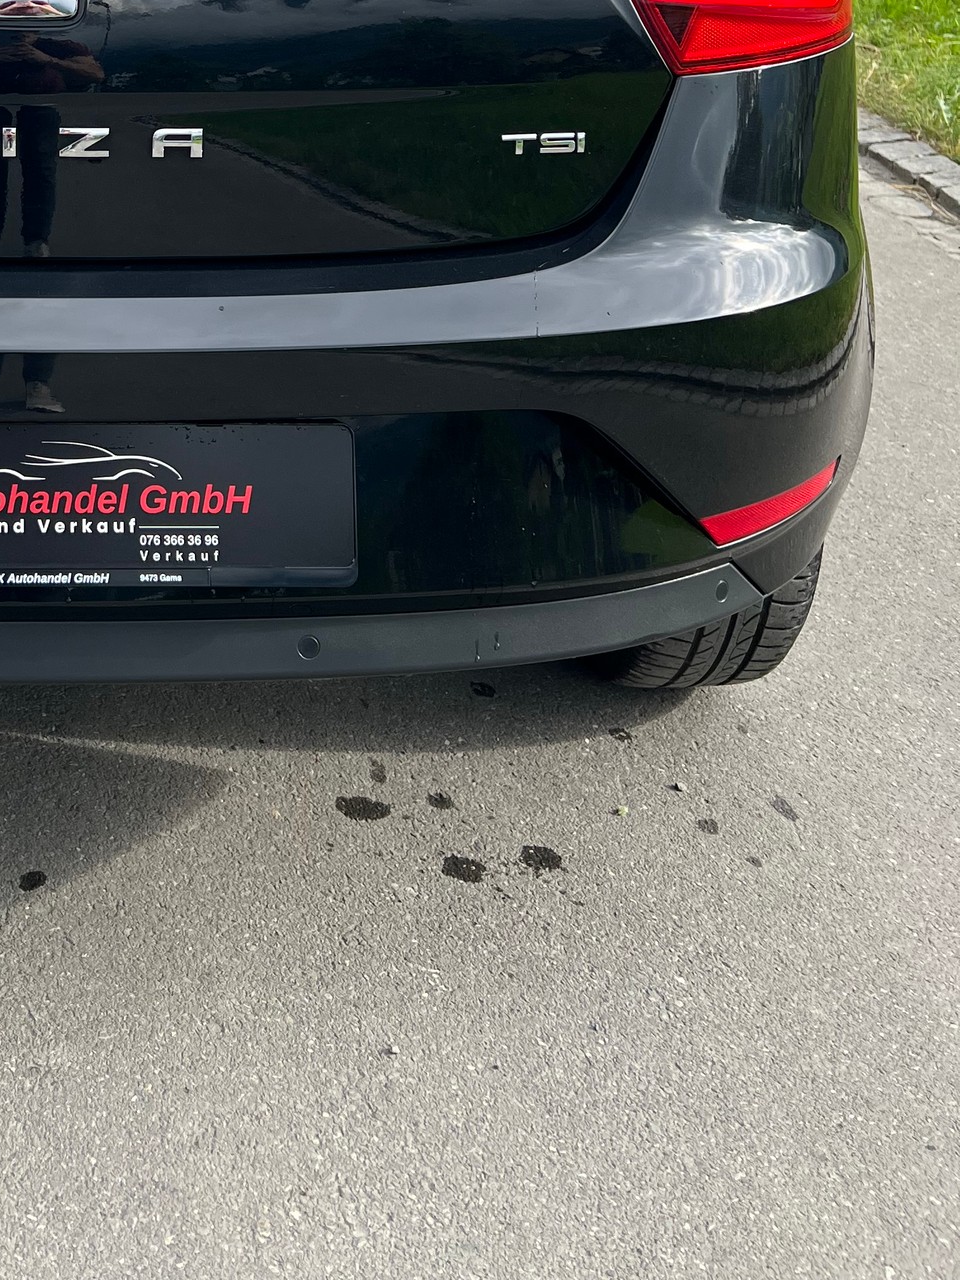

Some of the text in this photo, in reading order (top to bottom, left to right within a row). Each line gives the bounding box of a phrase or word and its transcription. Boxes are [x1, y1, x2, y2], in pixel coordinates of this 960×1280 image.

[501, 132, 586, 155] TSI
[139, 483, 253, 515] GmbH
[37, 517, 136, 534] Verkauf
[139, 534, 219, 546] 076 366 36 96
[139, 549, 219, 562] Verkauf
[6, 572, 72, 584] Autohandel
[73, 572, 110, 584] GmbH
[139, 573, 183, 583] 9473 Gams
